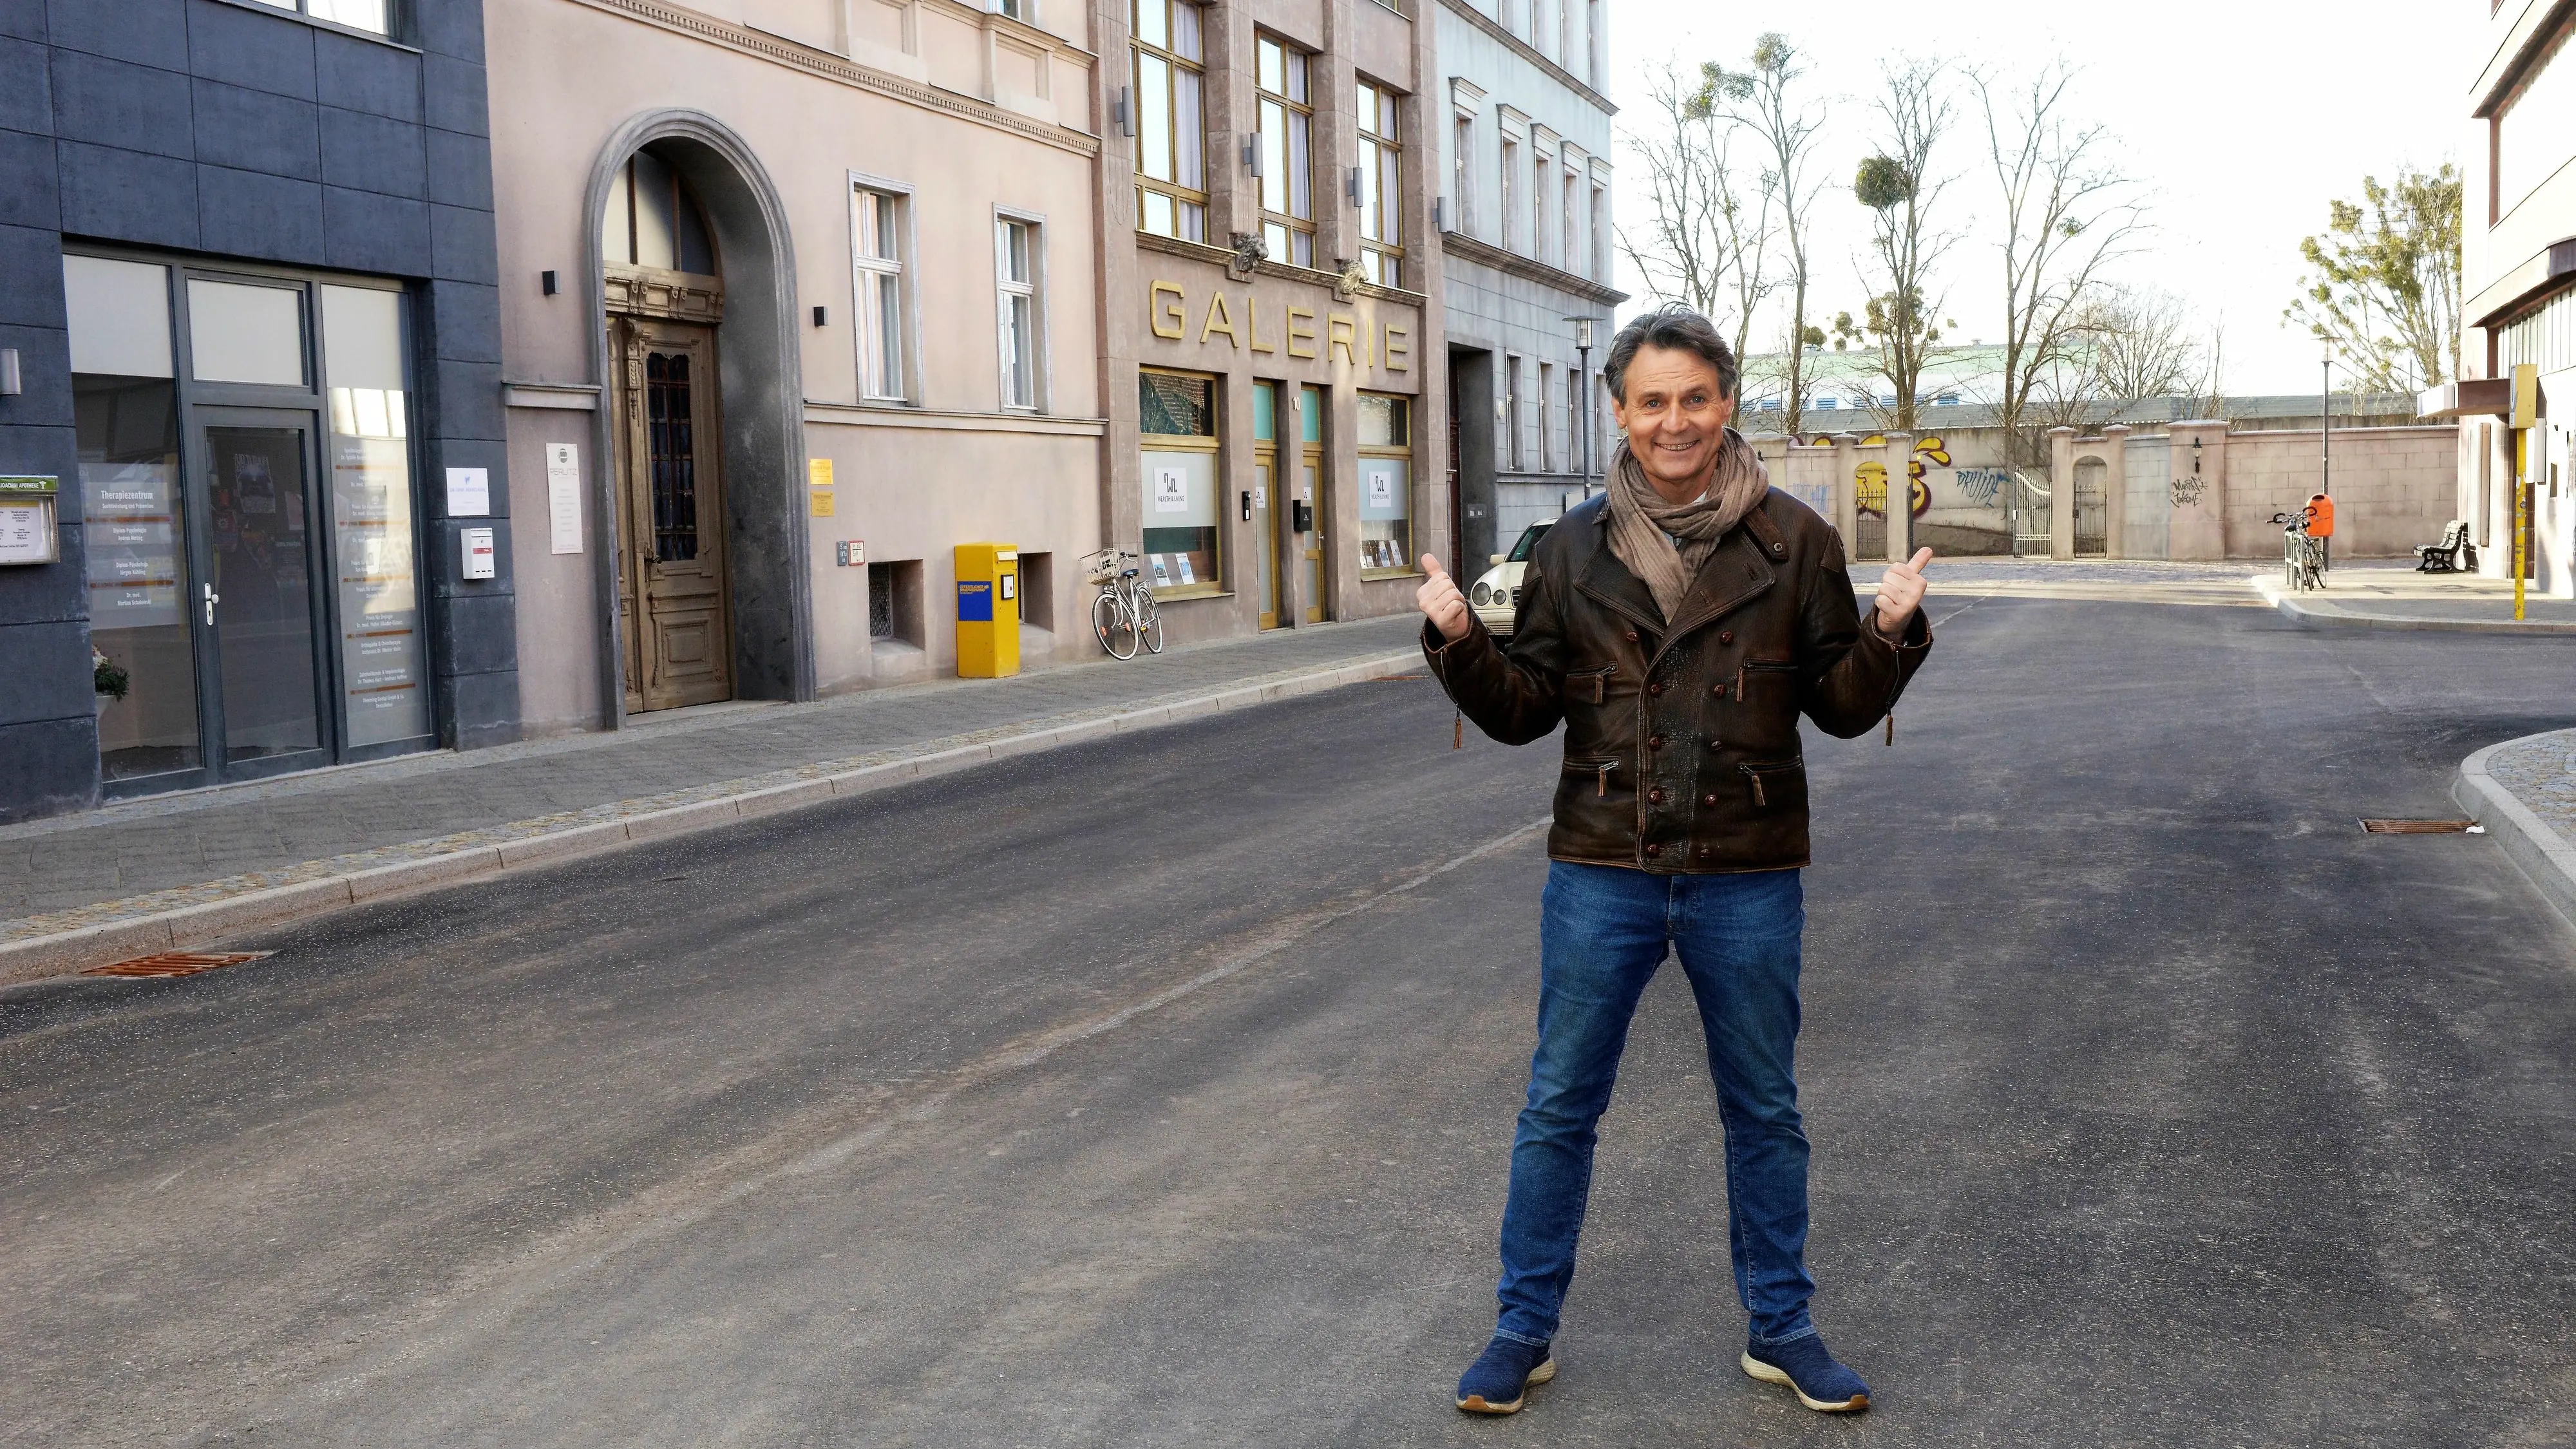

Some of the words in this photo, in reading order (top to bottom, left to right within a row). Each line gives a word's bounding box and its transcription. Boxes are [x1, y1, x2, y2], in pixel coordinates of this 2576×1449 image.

[1150, 279, 1408, 372] GALERIE
[1293, 396, 1300, 410] 10
[101, 490, 154, 501] Therapiezentrum
